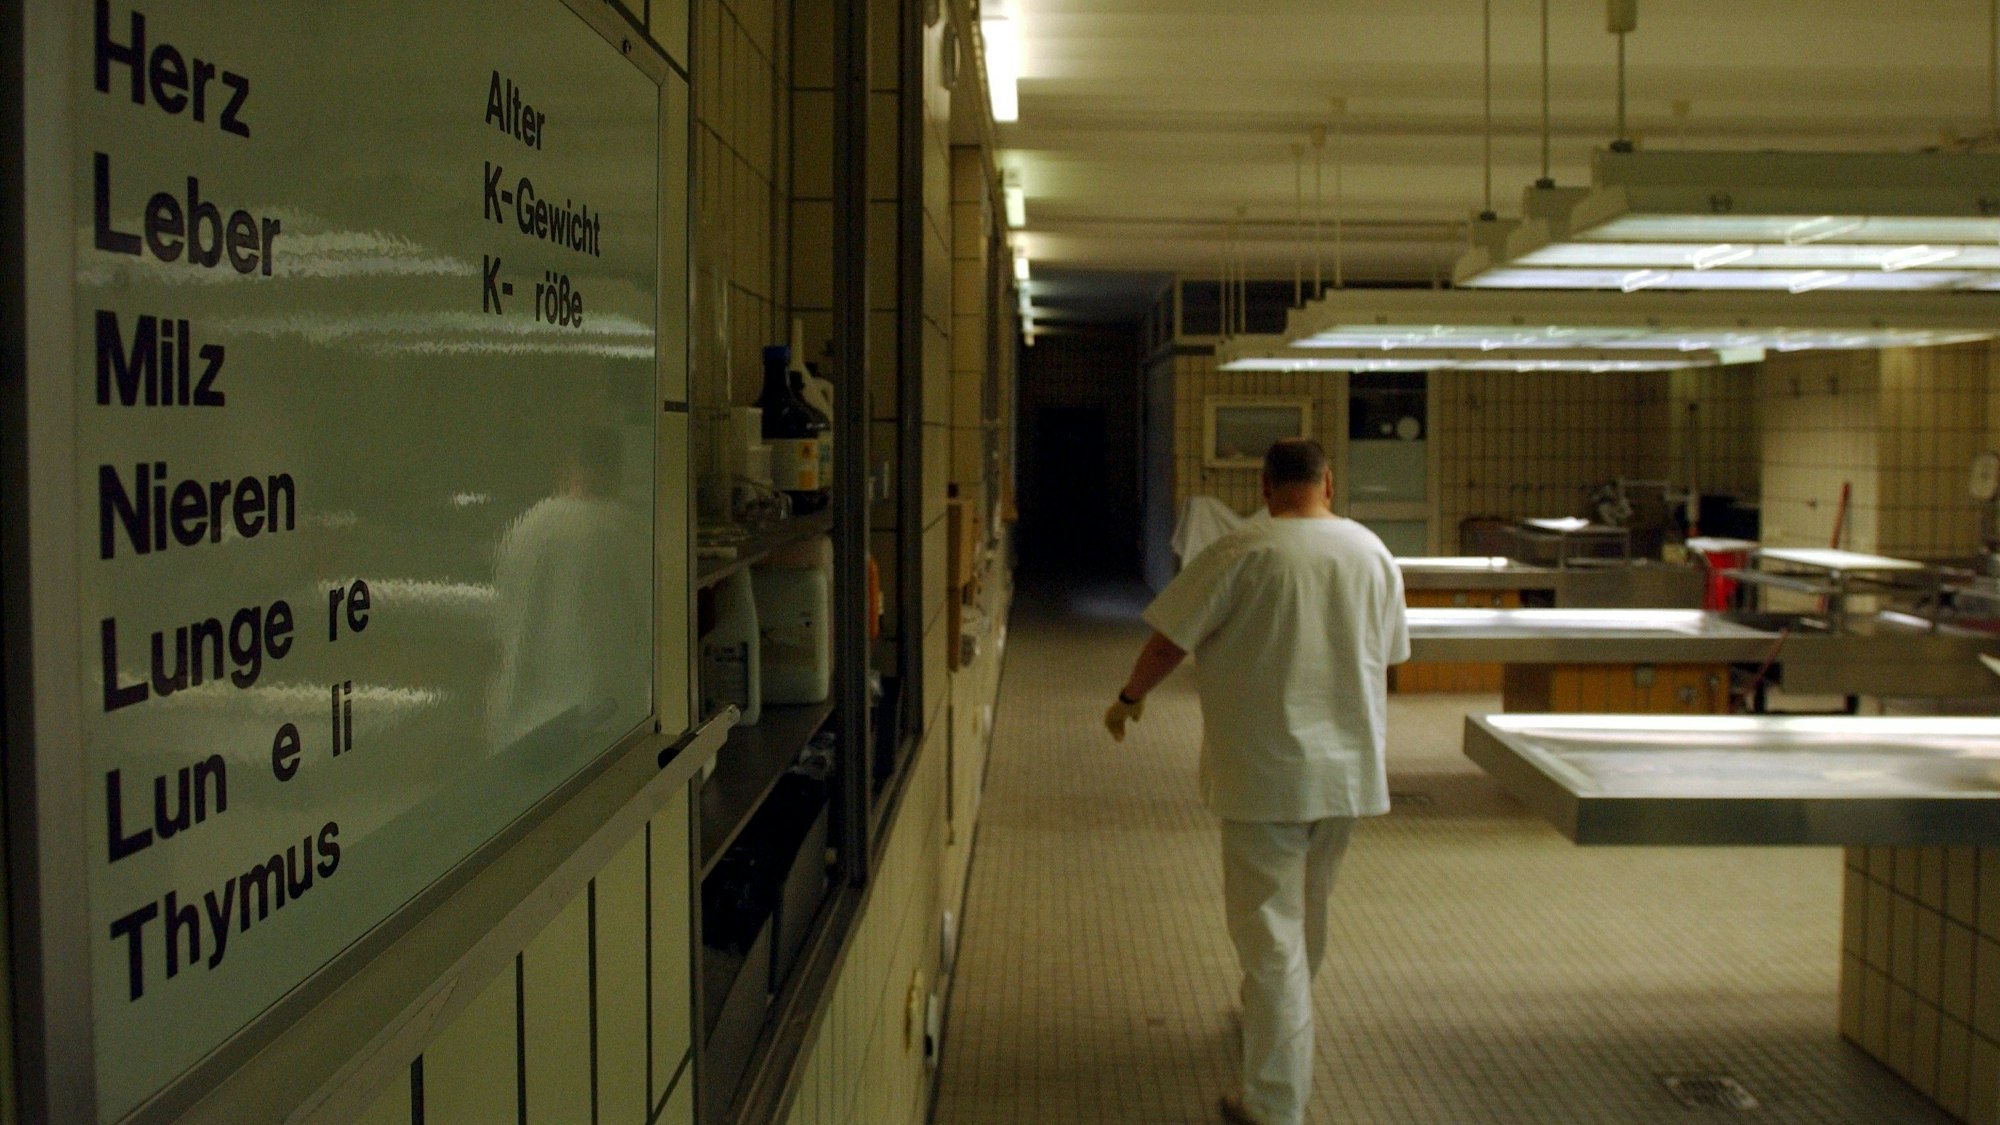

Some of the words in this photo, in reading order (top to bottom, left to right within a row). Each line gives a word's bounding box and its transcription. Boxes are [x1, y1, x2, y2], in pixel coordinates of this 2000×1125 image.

[94, 0, 250, 138] Herz
[485, 69, 546, 150] Alter
[94, 151, 280, 276] Leber
[484, 161, 600, 258] K-Gewicht
[95, 309, 225, 407] Milz
[99, 461, 295, 560] Nieren
[101, 600, 294, 713] Lunge
[329, 579, 370, 643] re
[331, 680, 352, 757] li
[110, 821, 341, 1002] Thymus
